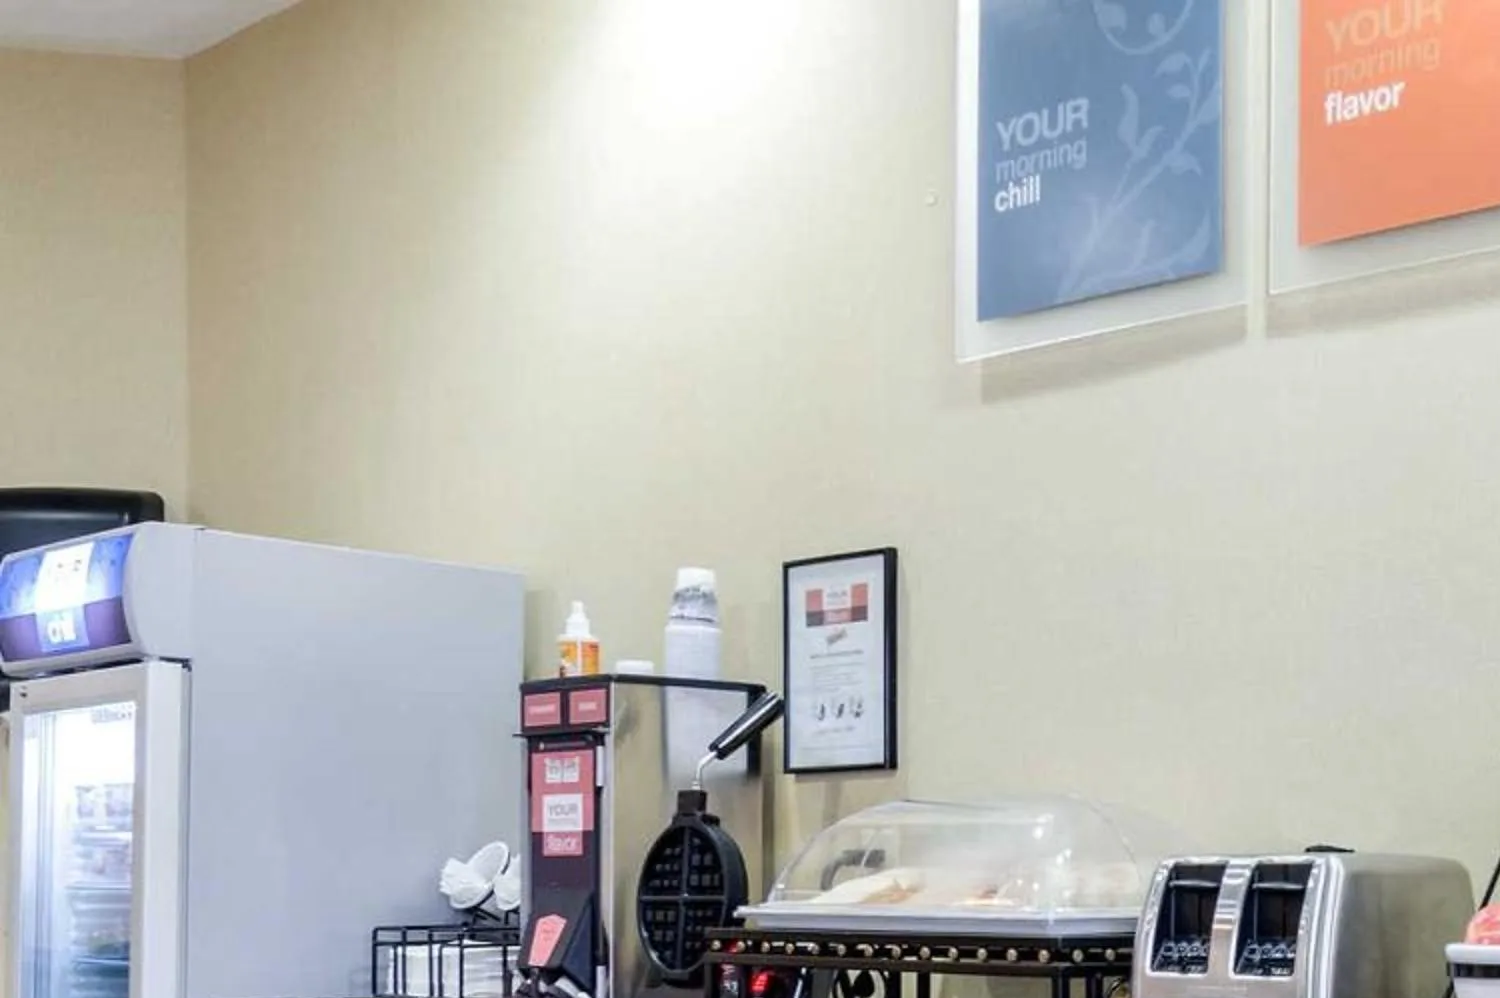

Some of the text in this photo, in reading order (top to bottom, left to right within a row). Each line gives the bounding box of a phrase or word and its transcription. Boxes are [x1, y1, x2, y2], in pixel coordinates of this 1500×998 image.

[1325, 0, 1443, 54] YOUR
[1325, 37, 1440, 91] morning
[995, 97, 1089, 152] YOUR
[1324, 81, 1405, 126] flavor
[996, 136, 1087, 184] morning
[994, 174, 1041, 212] chill
